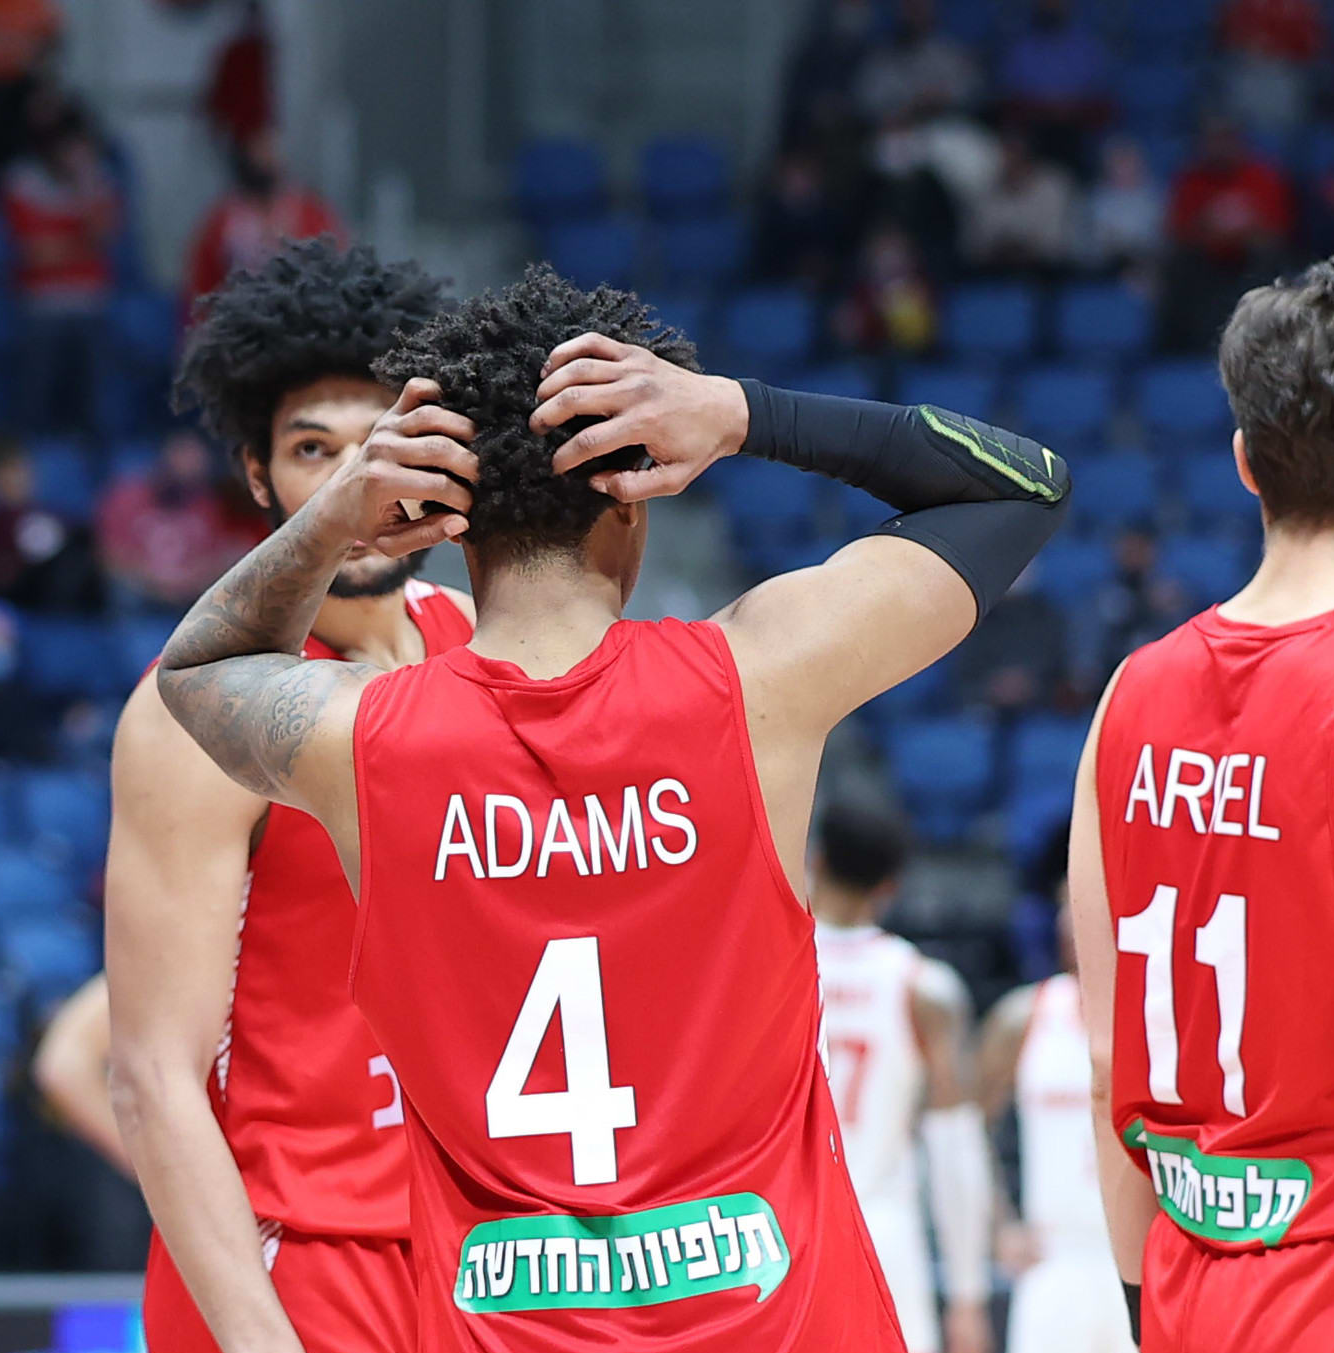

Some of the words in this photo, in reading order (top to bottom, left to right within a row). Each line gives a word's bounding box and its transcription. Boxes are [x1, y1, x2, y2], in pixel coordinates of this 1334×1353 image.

[434, 778, 698, 881] ADAMS
[1125, 743, 1280, 840] ARIEL
[1117, 883, 1247, 1118] 11
[485, 936, 637, 1185] 4
[462, 1236, 612, 1299] החדשה
[615, 1205, 783, 1293] תלפיות
